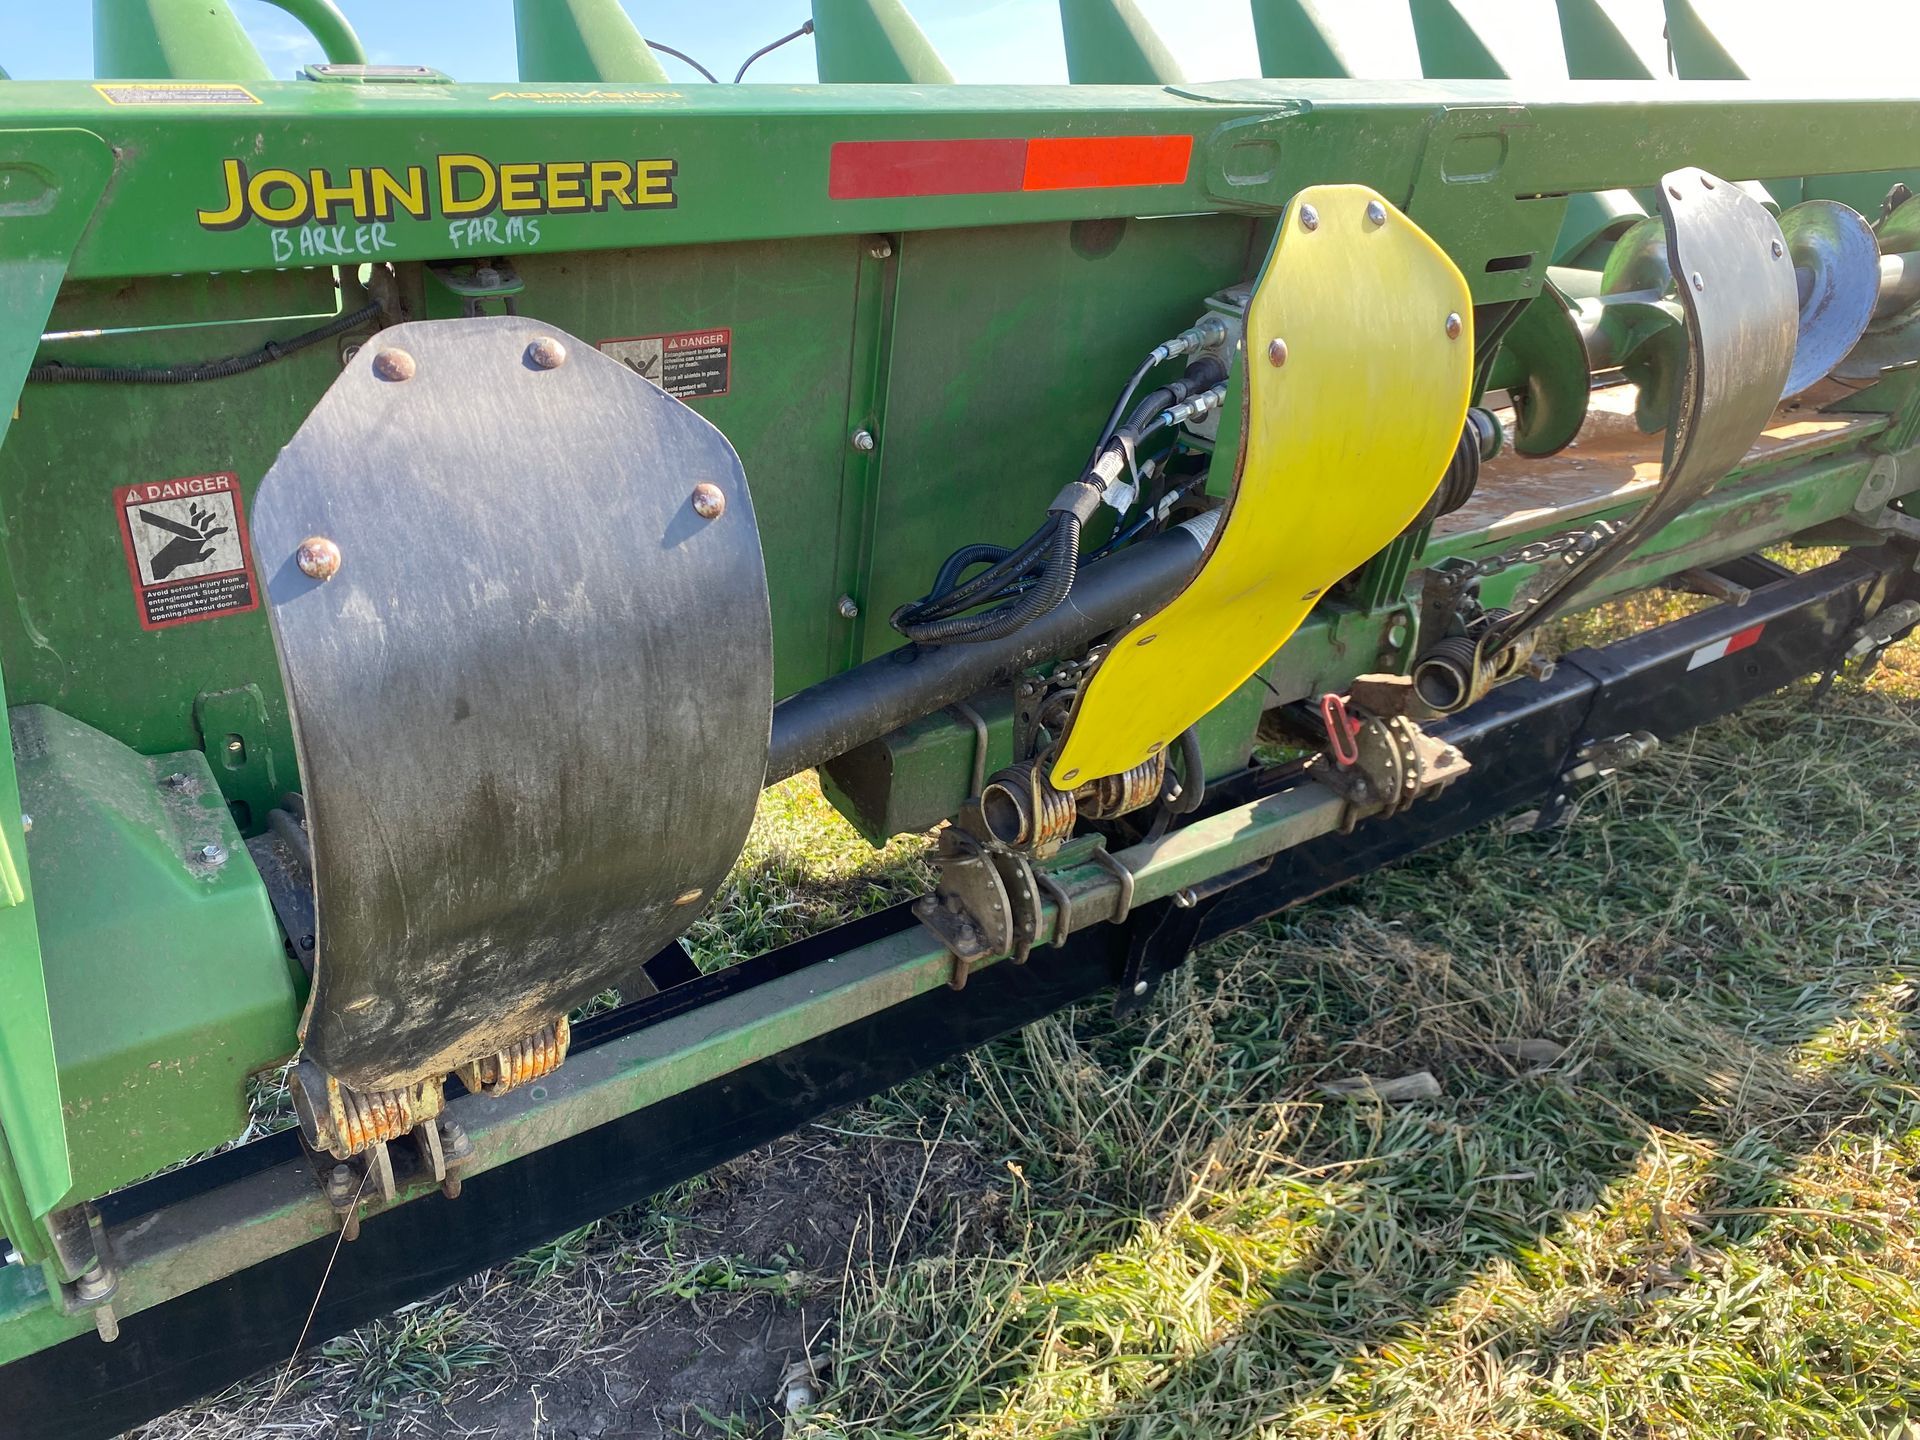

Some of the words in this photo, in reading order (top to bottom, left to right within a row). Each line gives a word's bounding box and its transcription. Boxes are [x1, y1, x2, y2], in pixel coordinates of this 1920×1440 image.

[197, 158, 431, 232] JOHN
[436, 153, 678, 218] DEERE
[271, 221, 397, 262] BARKER
[448, 217, 540, 249] FARMS
[680, 334, 724, 347] DANGER
[147, 476, 229, 499] DANGER
[147, 589, 169, 598] Avoid
[171, 584, 198, 594] serious
[222, 576, 240, 585] from
[148, 592, 201, 606] entanglement.
[202, 588, 220, 597] Stop
[150, 605, 164, 613] and
[166, 600, 193, 611] remove
[195, 598, 208, 606] key
[209, 593, 233, 602] before
[151, 610, 182, 621] opening
[216, 600, 240, 609] doors.
